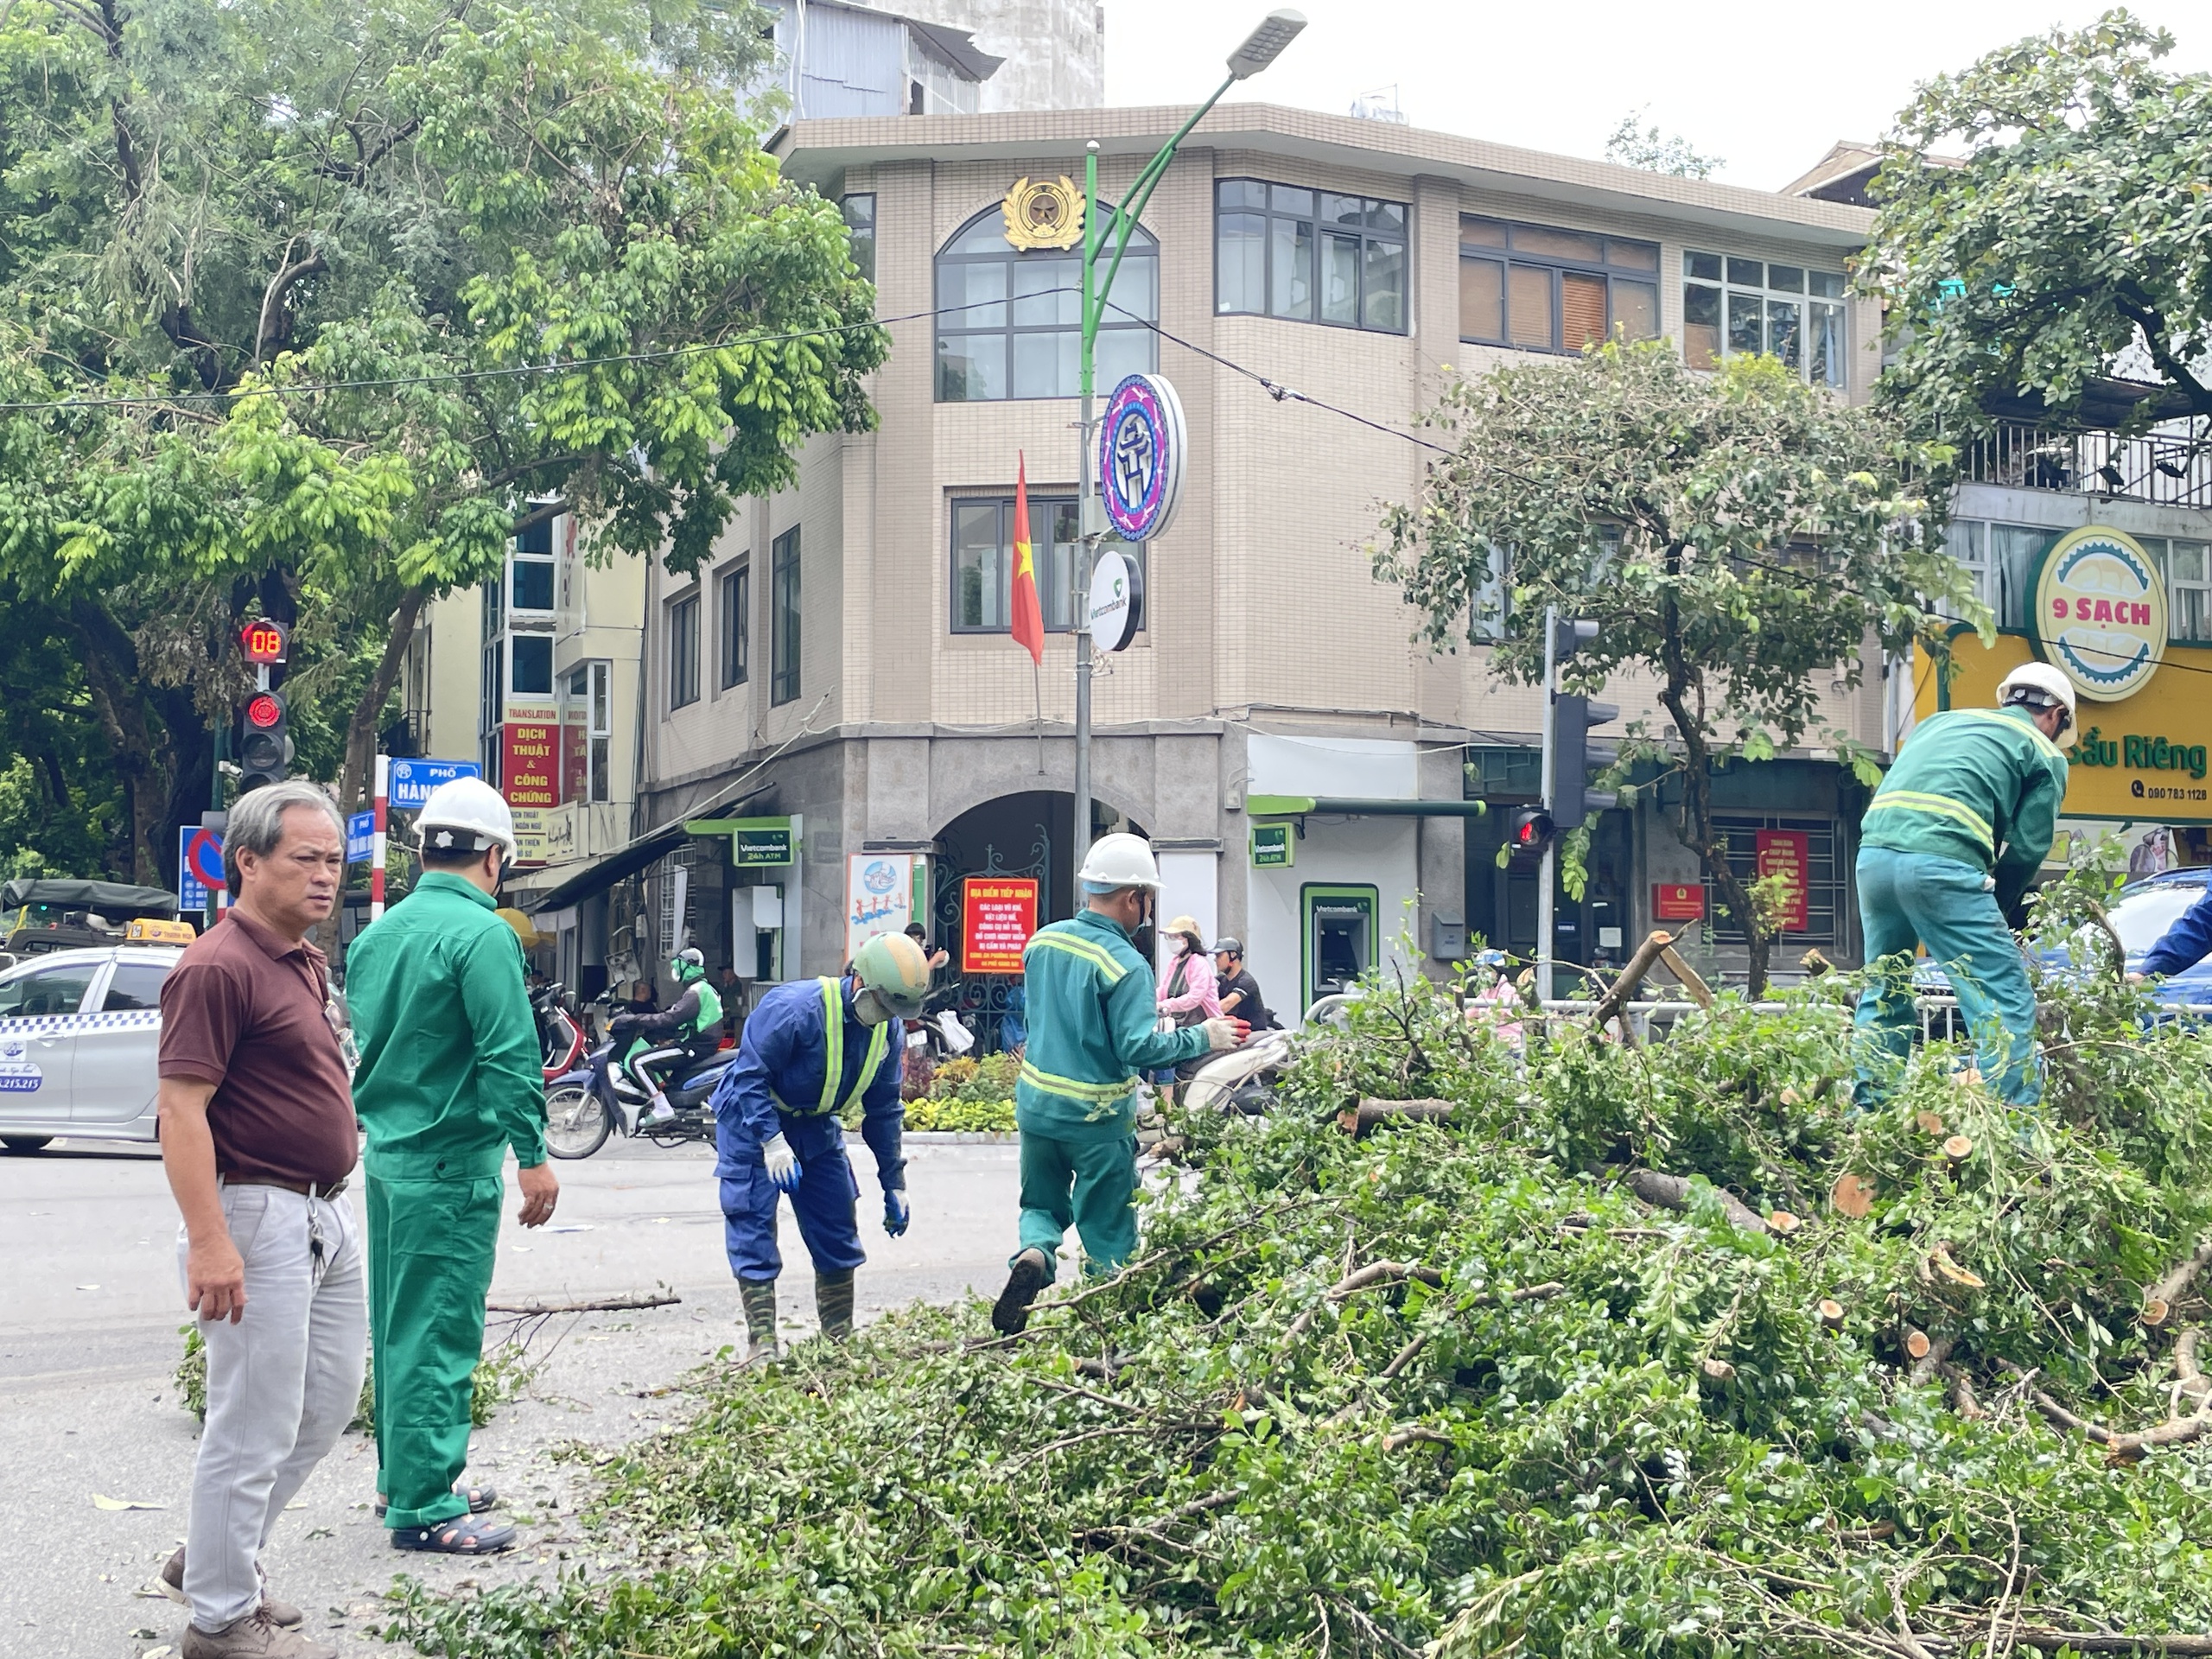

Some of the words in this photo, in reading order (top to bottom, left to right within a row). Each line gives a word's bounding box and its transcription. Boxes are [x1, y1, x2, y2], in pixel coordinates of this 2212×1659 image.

[2052, 598, 2069, 619] 9
[2076, 597, 2151, 629] SẠCH
[252, 630, 281, 653] 08
[509, 709, 556, 719] TRANSLATION
[518, 728, 546, 741] DỊCH
[513, 744, 550, 758] THUẬT
[2123, 734, 2208, 779] Riêng
[526, 760, 536, 769] &
[429, 766, 456, 778] PHỐ
[514, 773, 548, 786] CÔNG
[510, 791, 552, 804] CHỨNG
[2167, 787, 2185, 800] 783
[2187, 789, 2208, 801] 1128
[740, 843, 788, 852] Vietcombank
